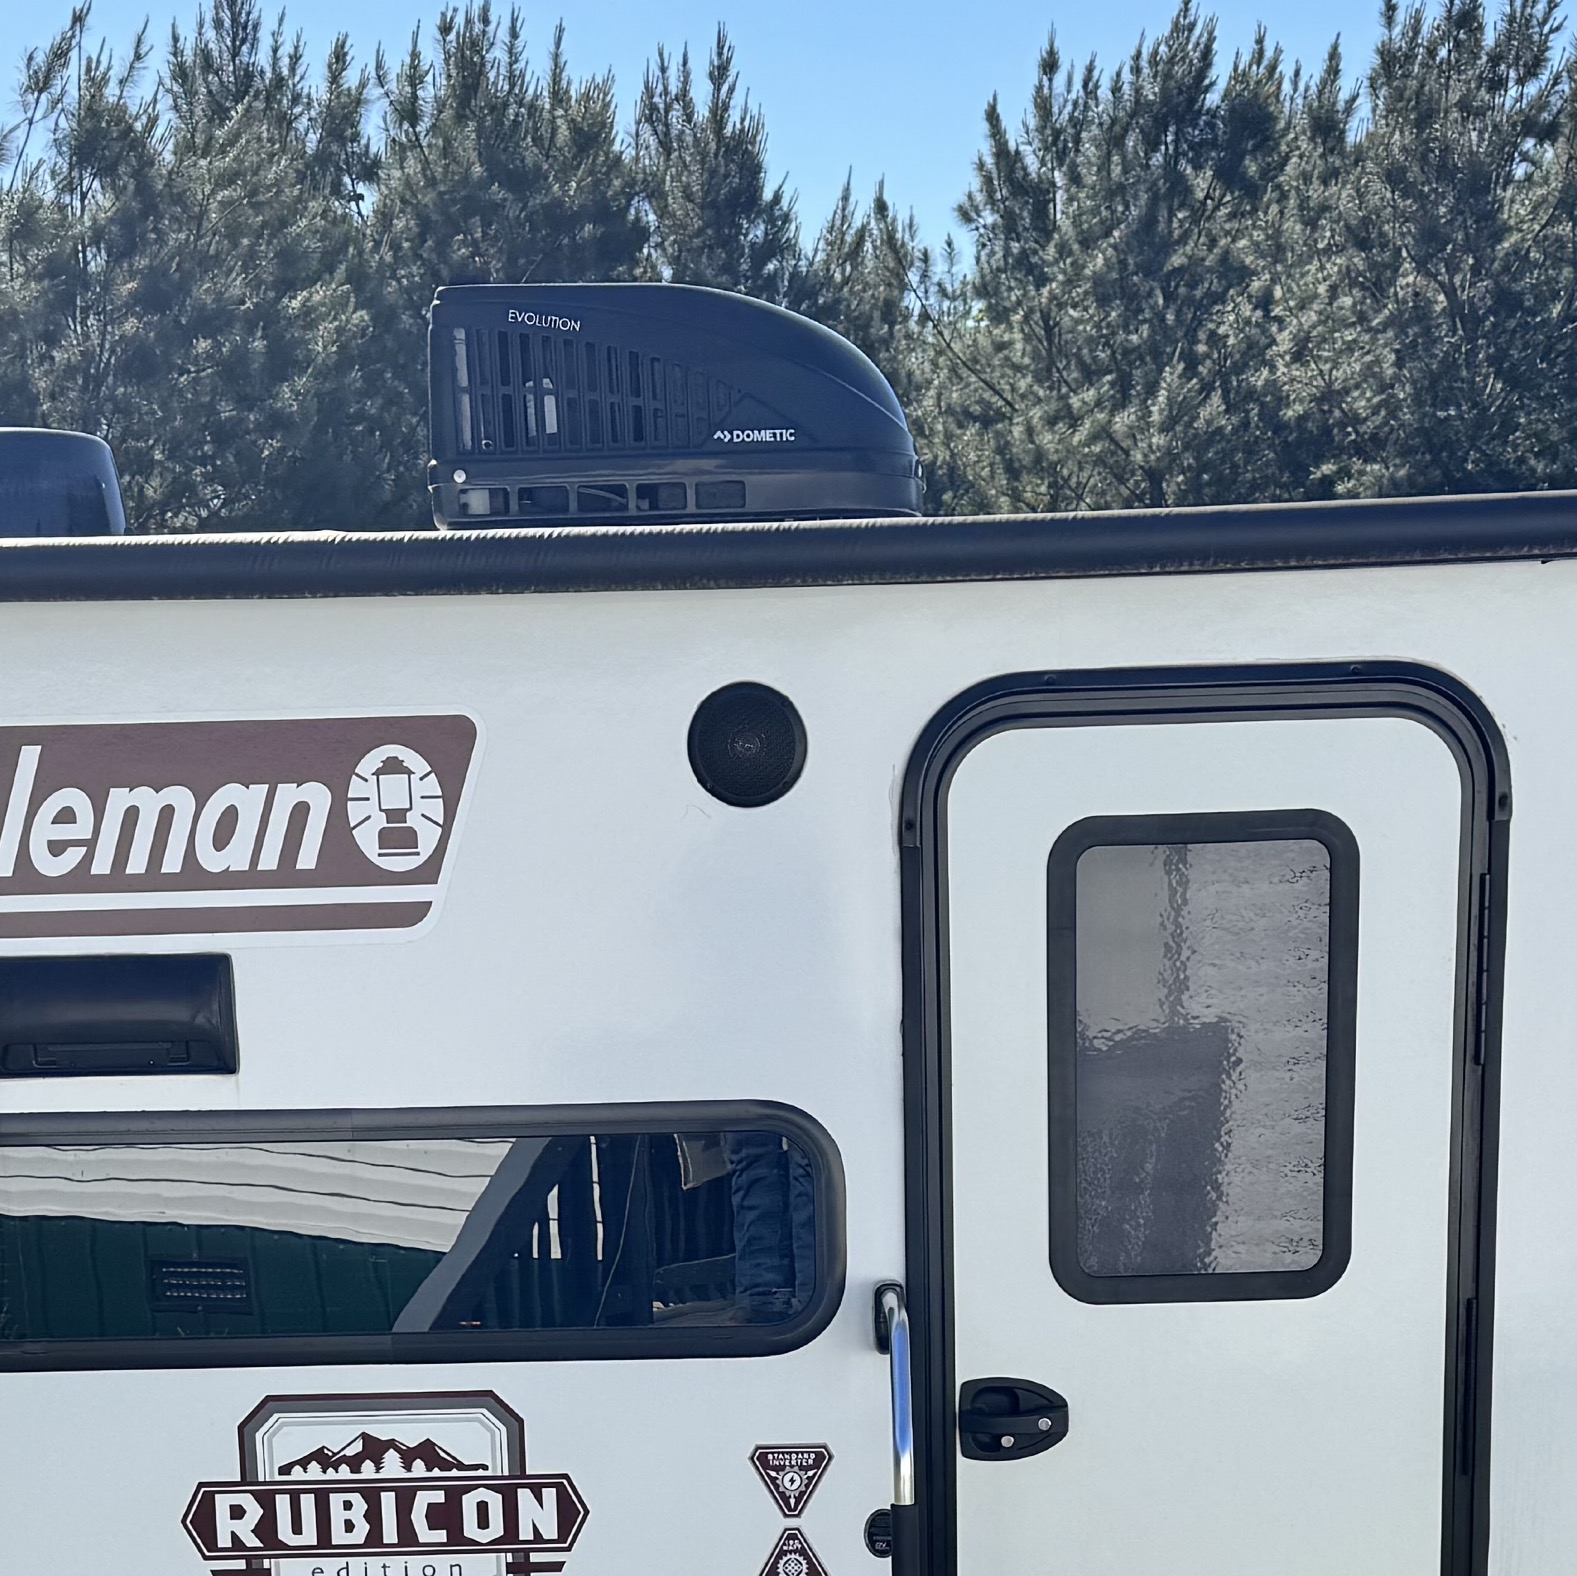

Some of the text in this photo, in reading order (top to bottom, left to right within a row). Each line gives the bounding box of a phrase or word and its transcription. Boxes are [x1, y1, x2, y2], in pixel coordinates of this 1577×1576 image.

[508, 309, 581, 332] EVOLUTION
[732, 429, 795, 443] DOMETIC
[214, 1486, 559, 1549] RUBICON
